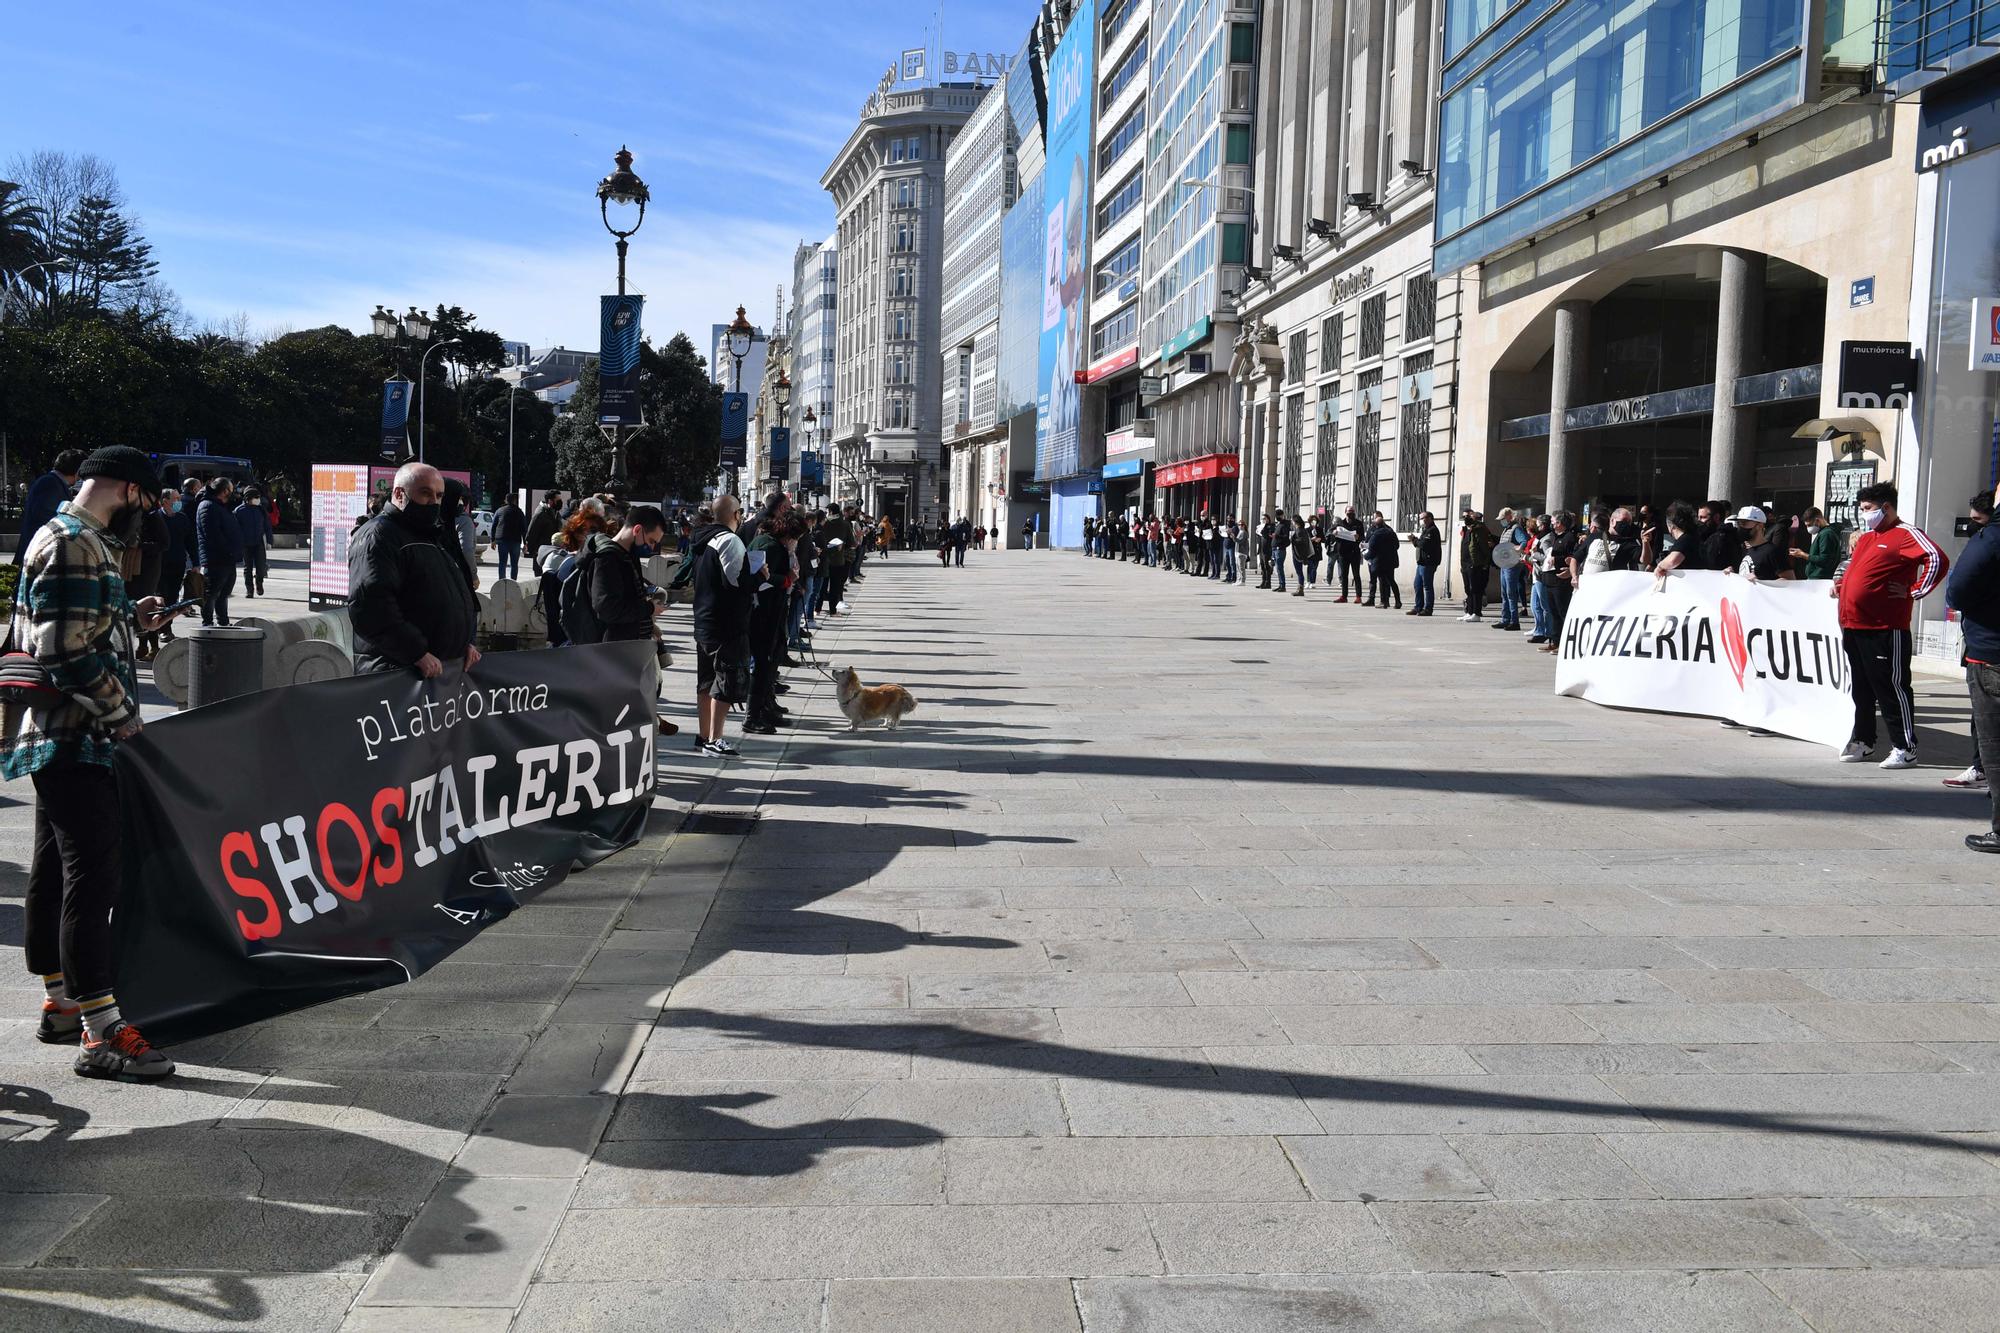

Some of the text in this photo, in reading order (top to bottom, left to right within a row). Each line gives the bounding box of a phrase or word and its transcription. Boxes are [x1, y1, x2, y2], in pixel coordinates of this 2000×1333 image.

[1338, 266, 1374, 301] Santander
[1613, 398, 1649, 423] ONCE
[220, 704, 654, 942] SHOSTALERÍA
